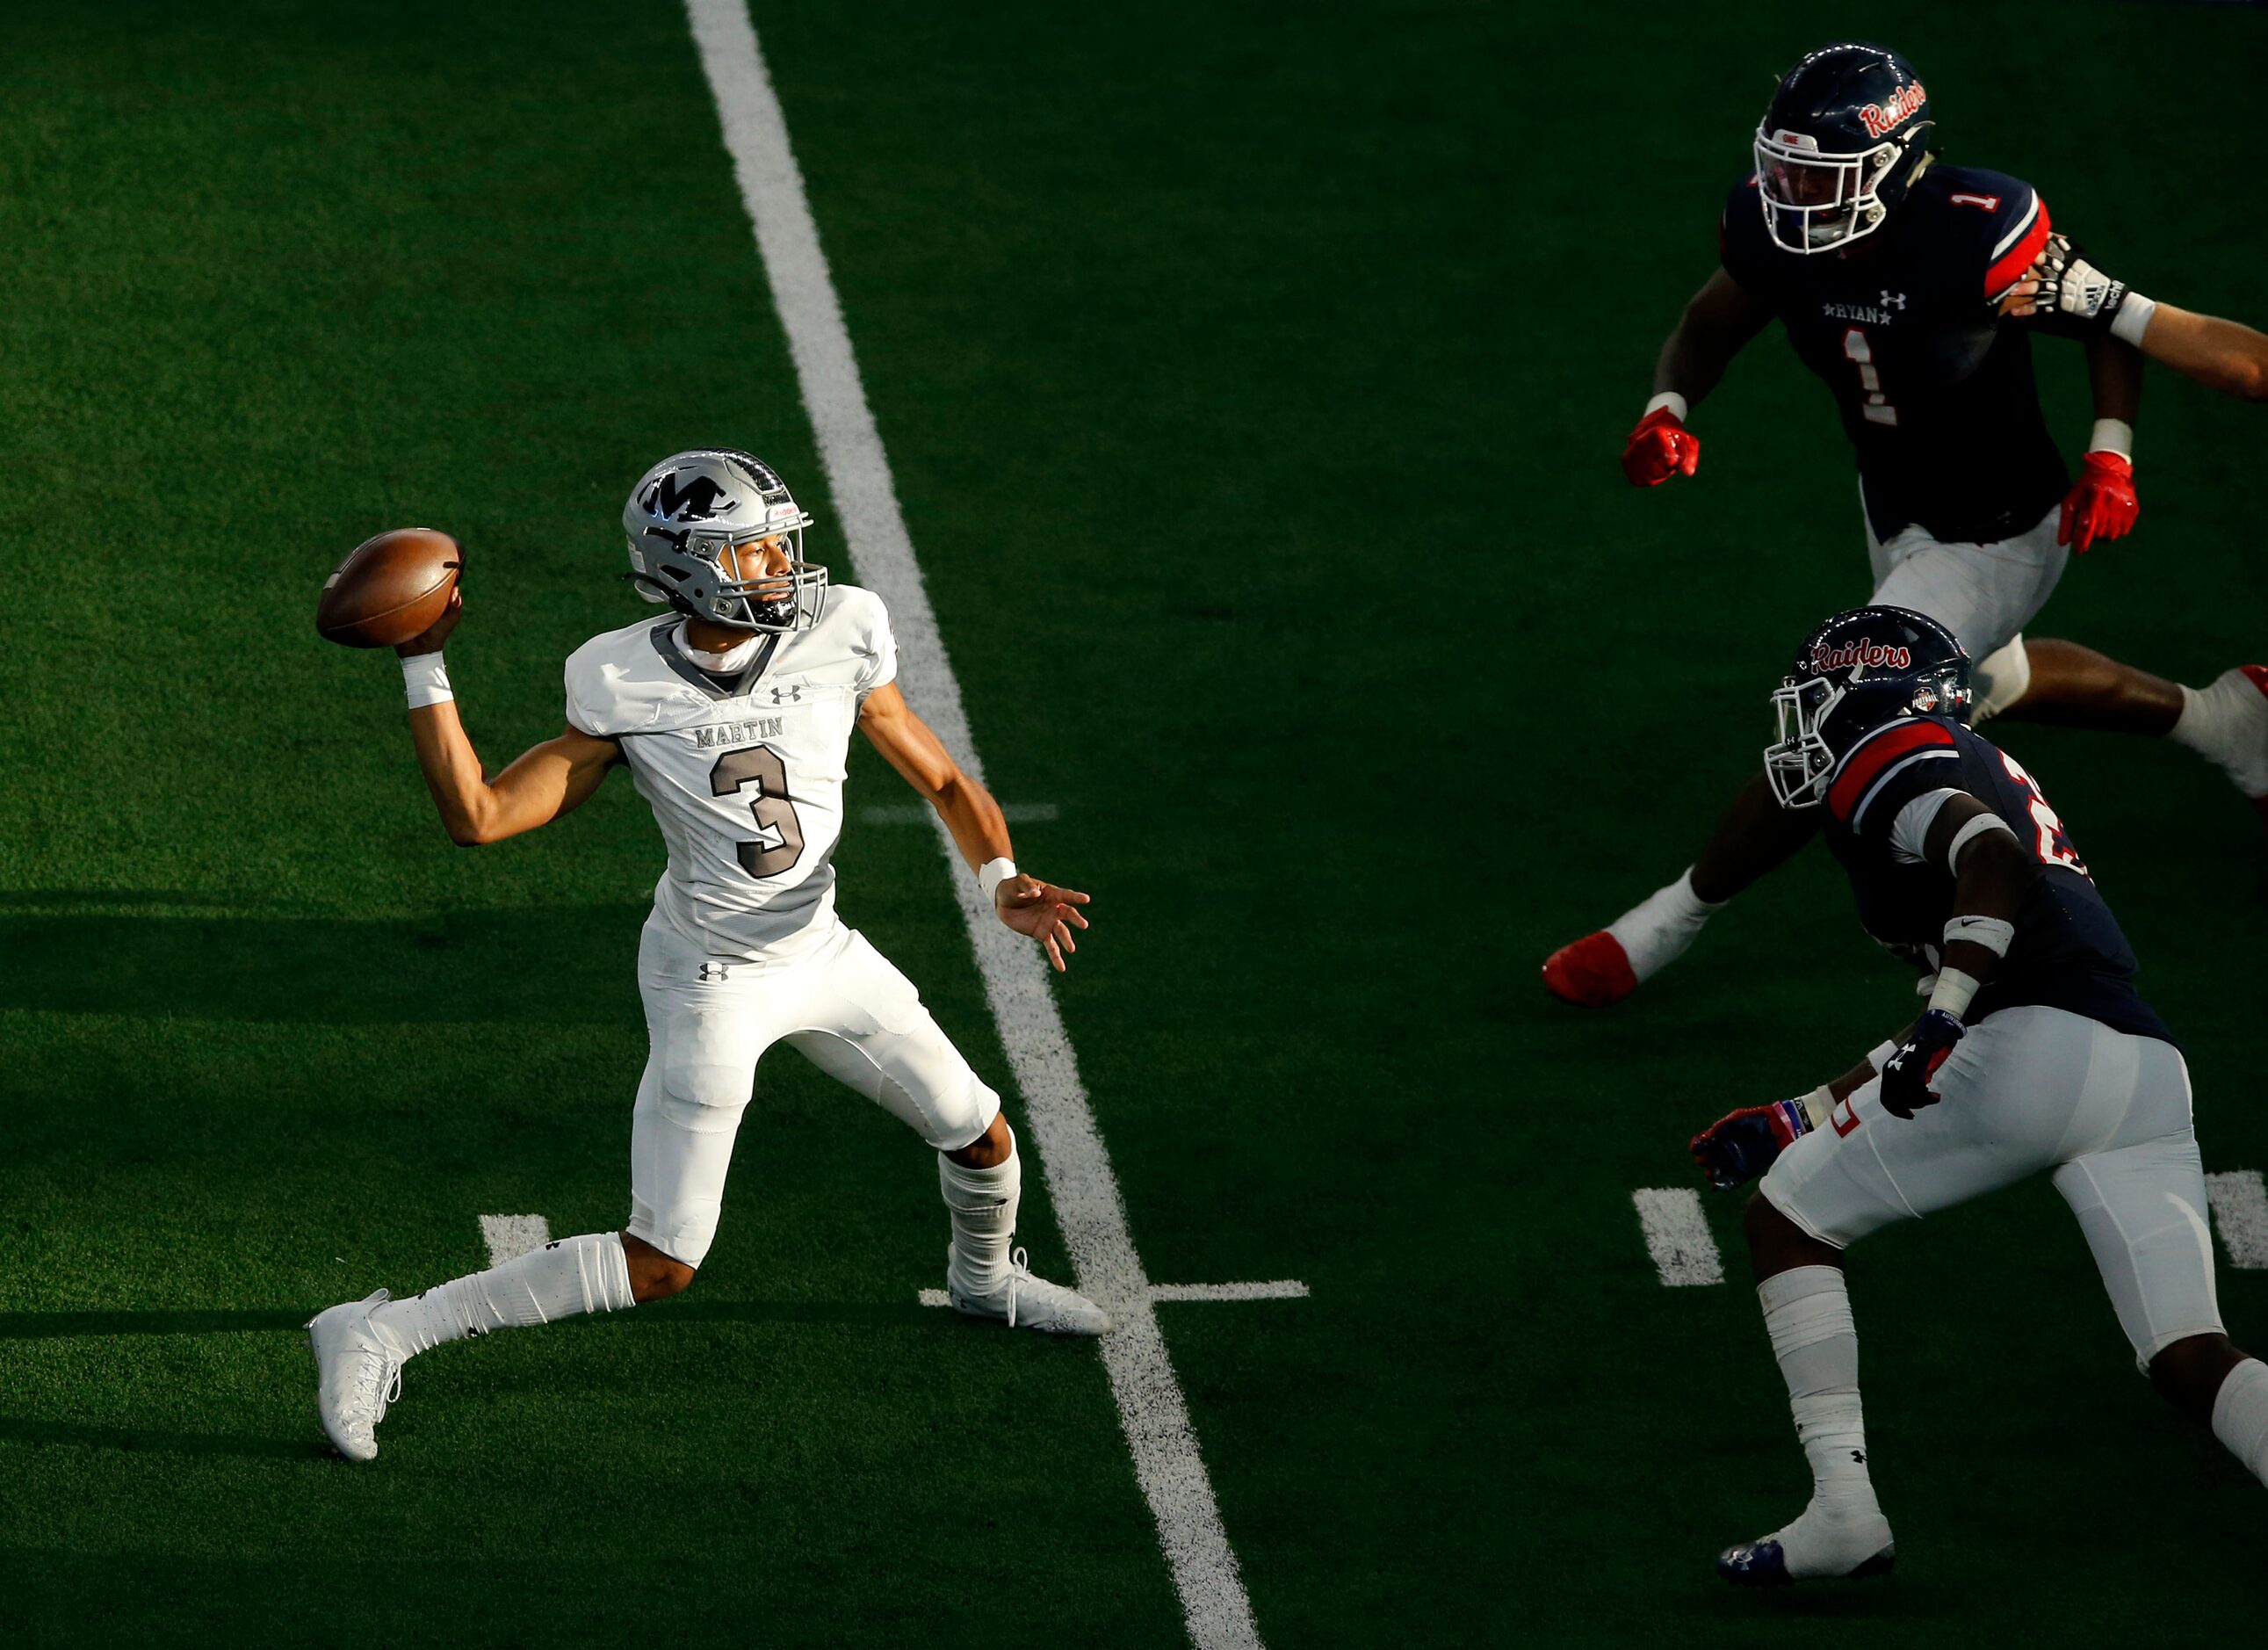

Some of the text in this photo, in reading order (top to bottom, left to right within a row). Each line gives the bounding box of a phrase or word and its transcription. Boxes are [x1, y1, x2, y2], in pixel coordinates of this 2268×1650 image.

[1947, 191, 2002, 213] 1
[1836, 303, 1878, 324] RYAN
[1841, 324, 1902, 430] 1
[1810, 637, 1911, 674] Raiders
[695, 717, 784, 749] MARTIN
[710, 744, 805, 879] 3
